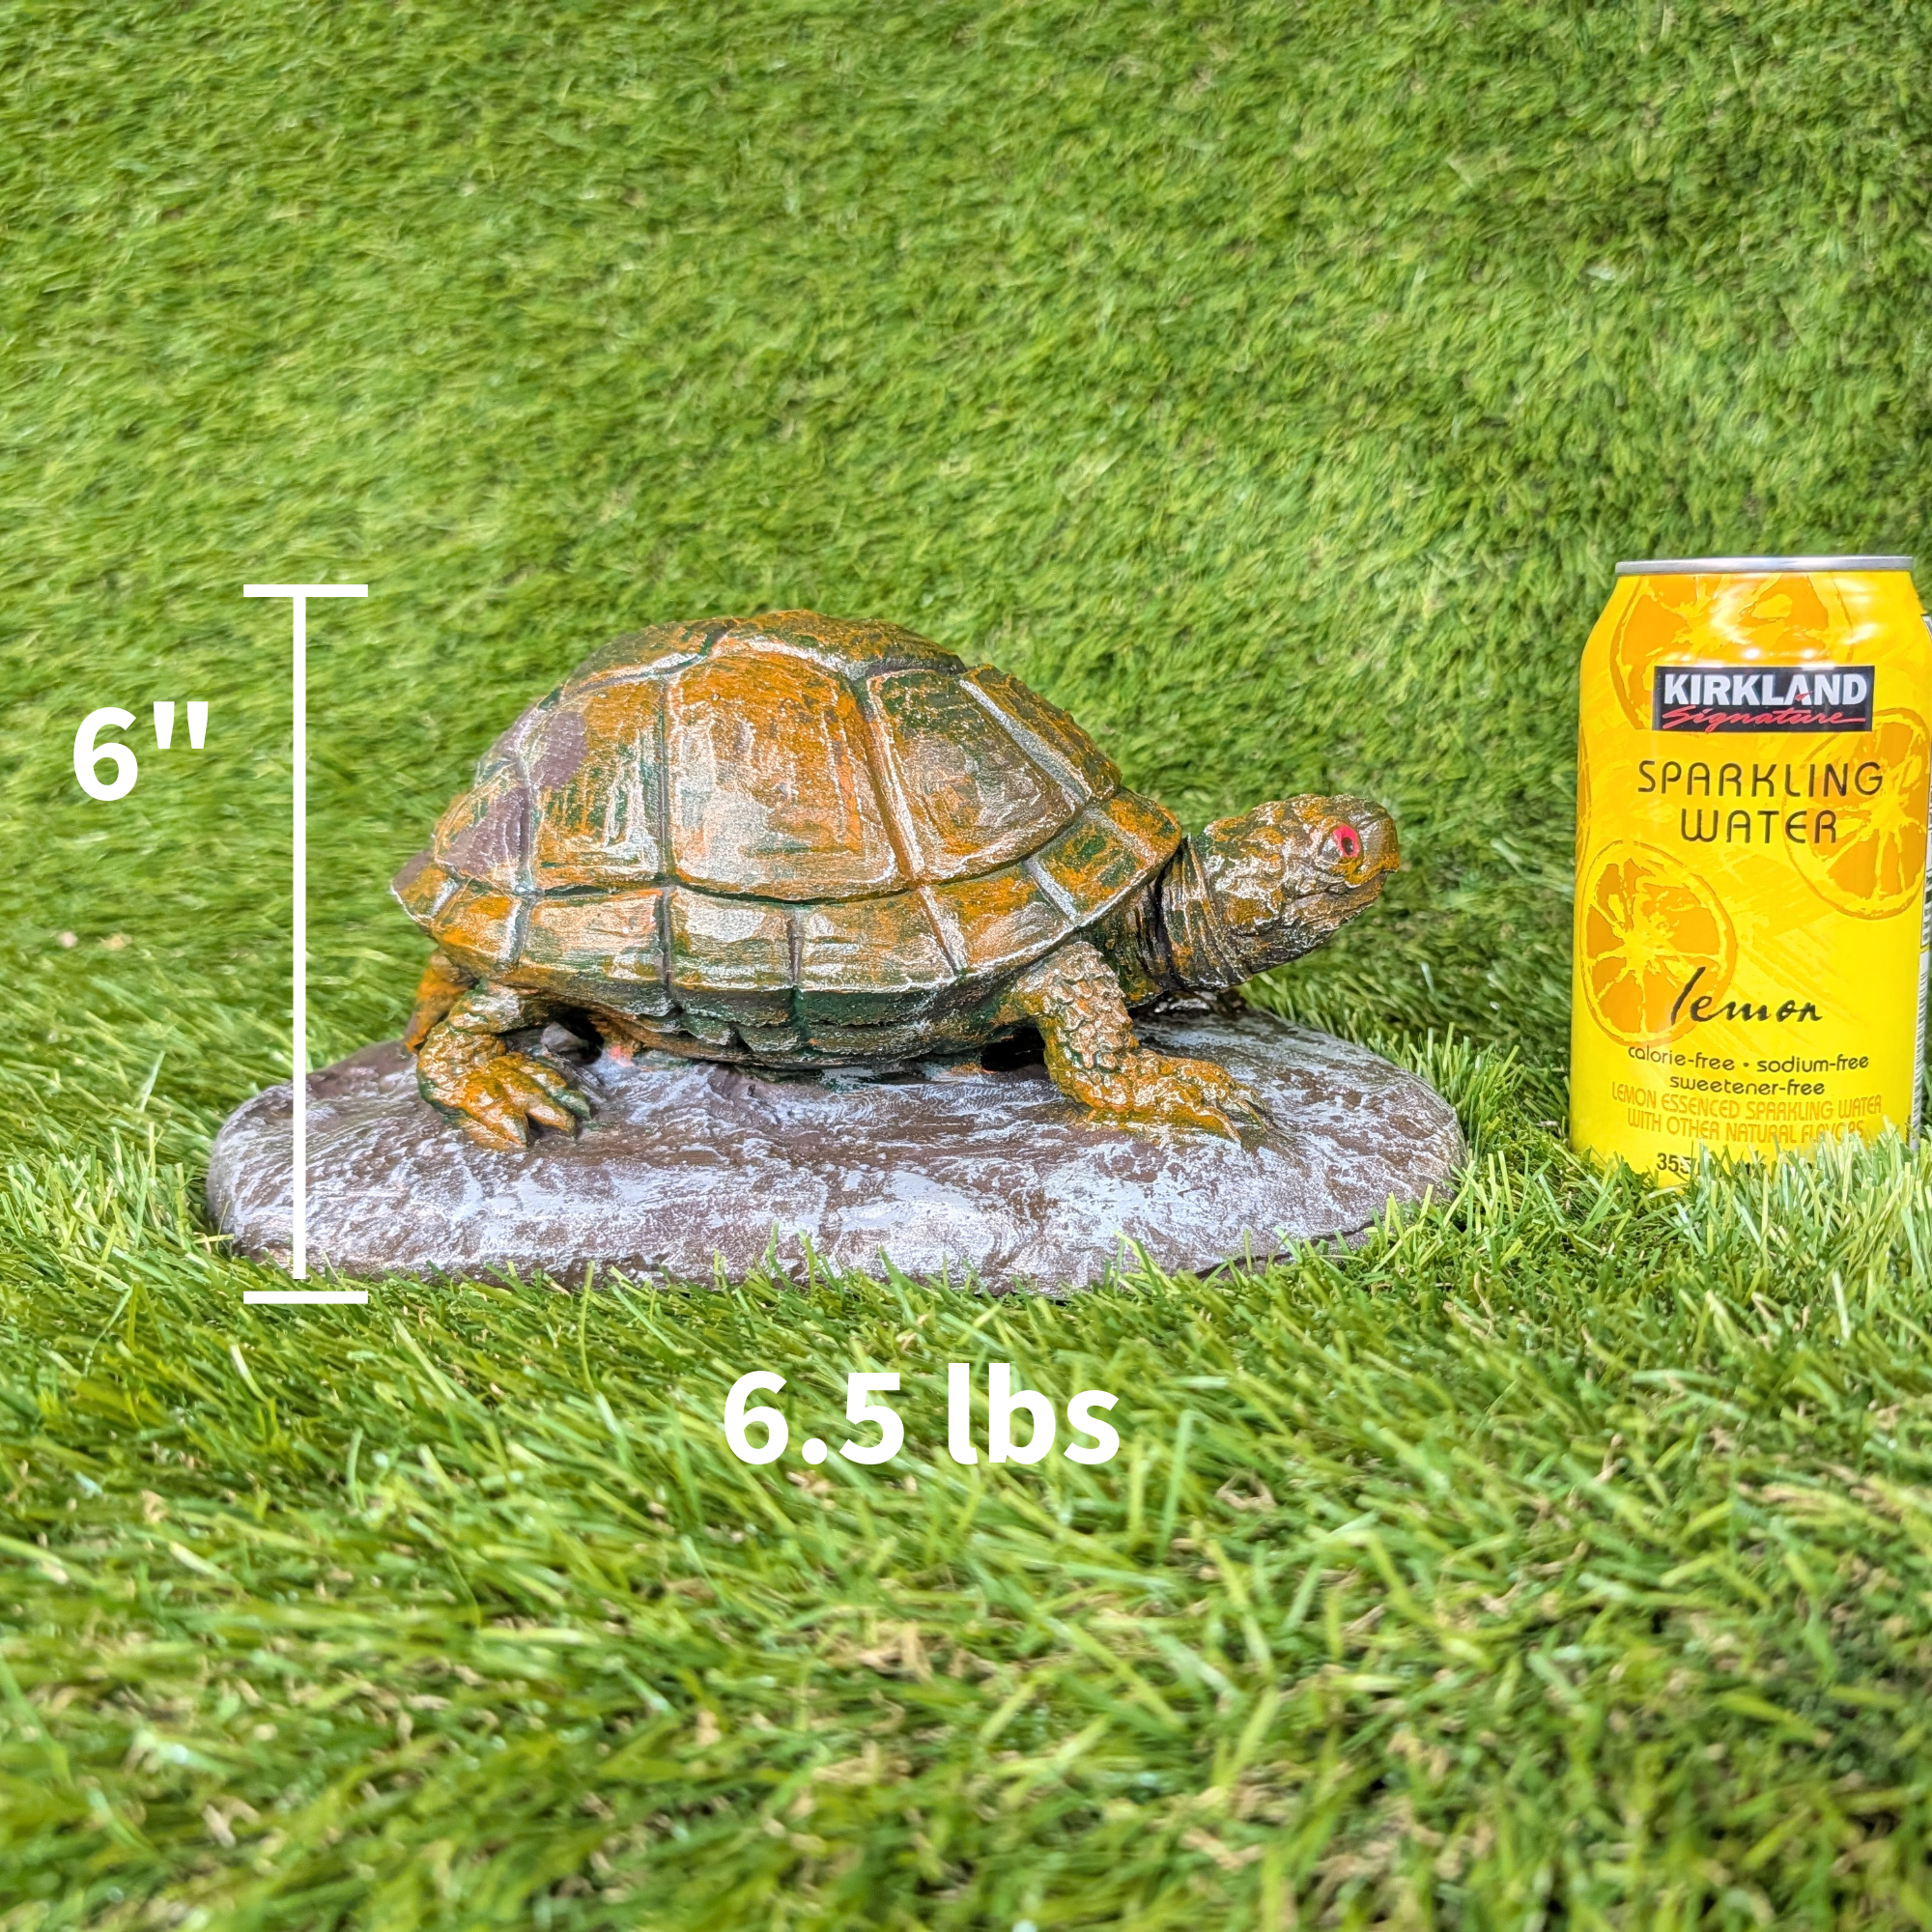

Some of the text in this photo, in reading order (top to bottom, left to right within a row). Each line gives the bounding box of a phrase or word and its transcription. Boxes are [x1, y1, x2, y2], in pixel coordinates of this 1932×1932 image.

[1663, 673, 1867, 705] KIRKLAND
[1662, 704, 1866, 734] Signature
[1637, 760, 1883, 798] SPARKLING
[1681, 808, 1837, 844] WATER
[1670, 966, 1823, 1023] lemon
[1628, 1044, 1869, 1073] calorie-free sodium-free
[1611, 1081, 1882, 1122] LEMON ESSENCED SPARKLING WATER
[1669, 1074, 1826, 1096] sweetener-free
[1628, 1107, 1662, 1133] WITH
[1666, 1116, 1719, 1141] OTHER
[1725, 1122, 1798, 1145] NATURAL
